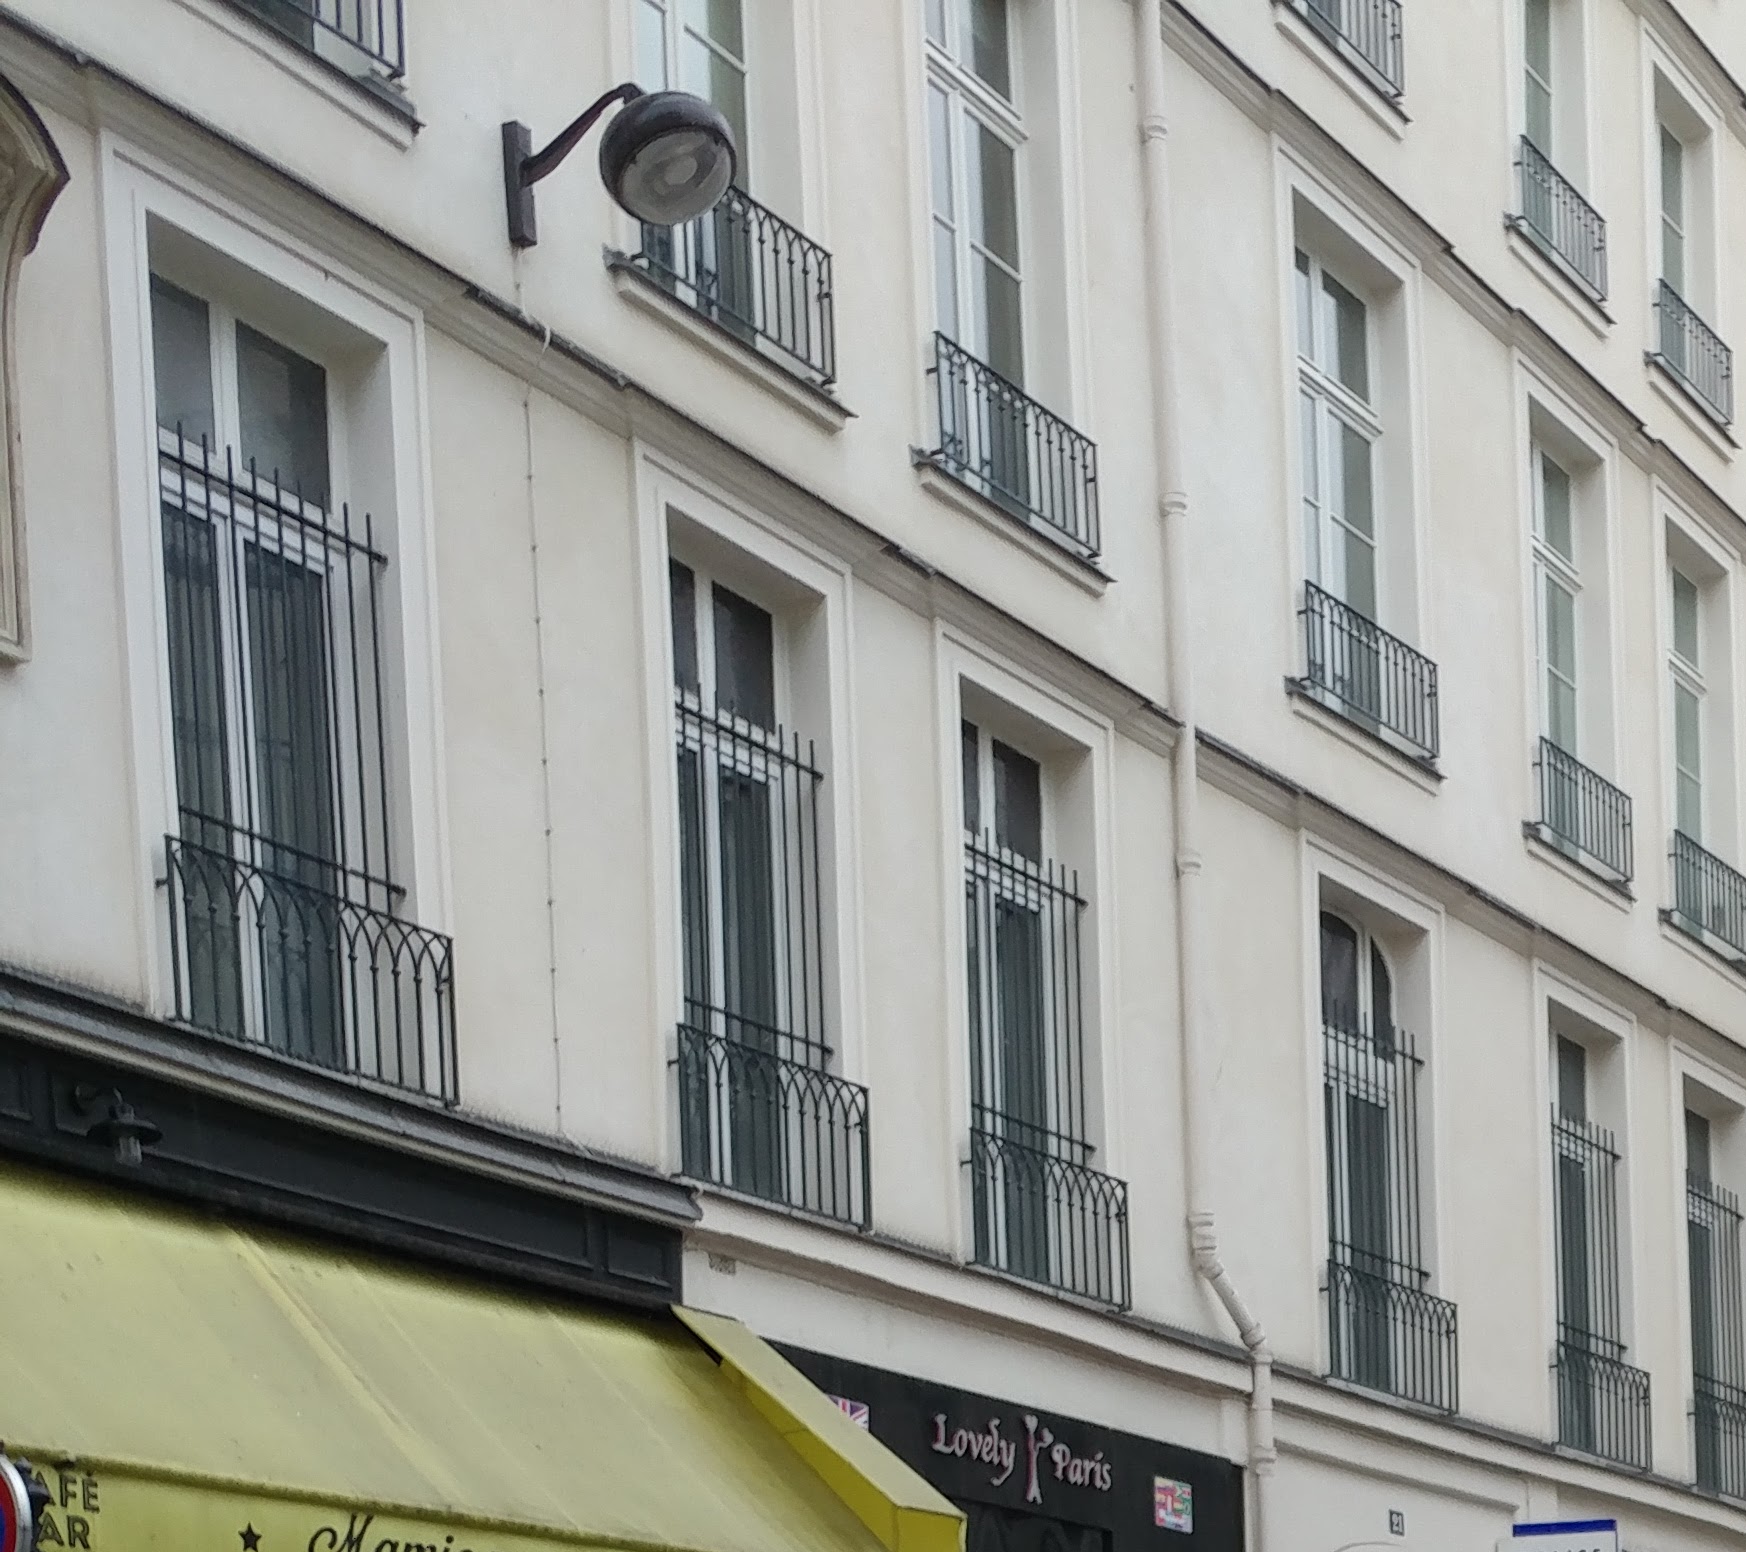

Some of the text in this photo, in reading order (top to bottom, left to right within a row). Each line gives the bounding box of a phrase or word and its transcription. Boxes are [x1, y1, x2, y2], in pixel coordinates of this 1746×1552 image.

[932, 1413, 1112, 1491] Lovely Paris
[39, 1511, 91, 1550] AR
